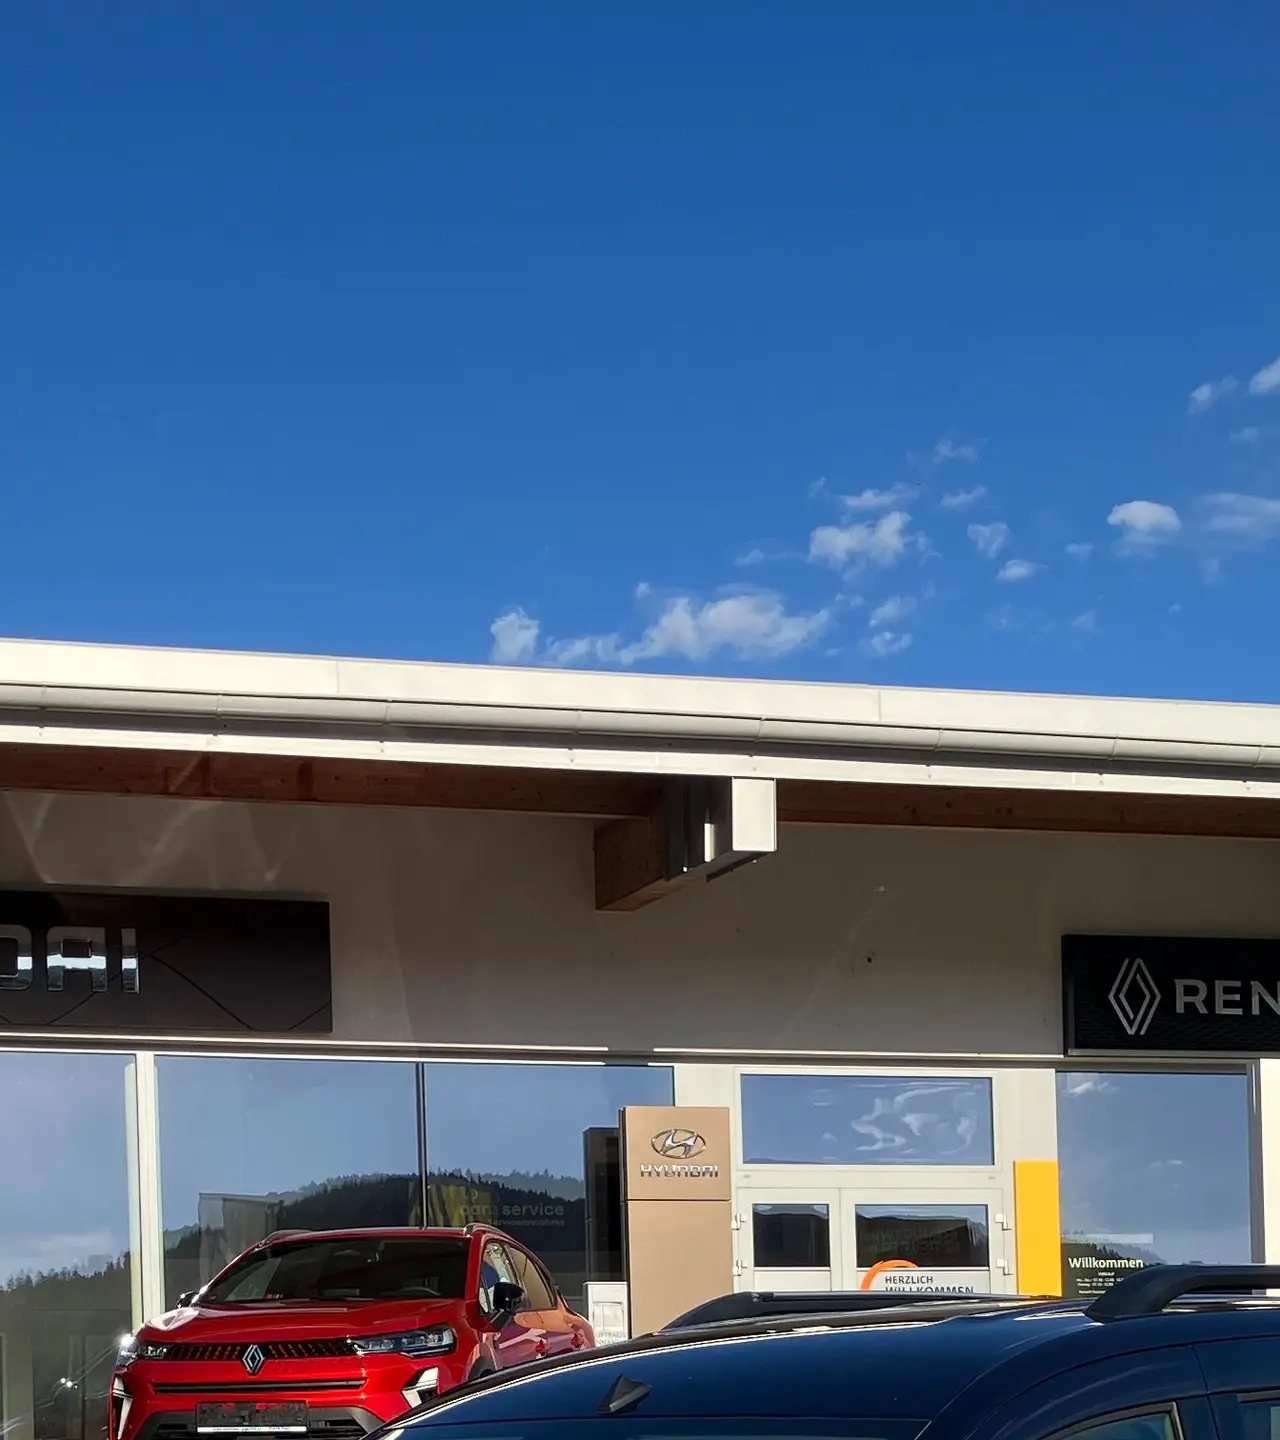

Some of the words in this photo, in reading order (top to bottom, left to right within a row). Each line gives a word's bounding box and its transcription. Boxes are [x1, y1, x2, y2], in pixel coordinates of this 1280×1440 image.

[640, 1164, 719, 1178] HYUNDAI
[501, 1201, 566, 1217] service
[1068, 1256, 1144, 1269] Willkommen
[885, 1275, 934, 1284] HERZLICH
